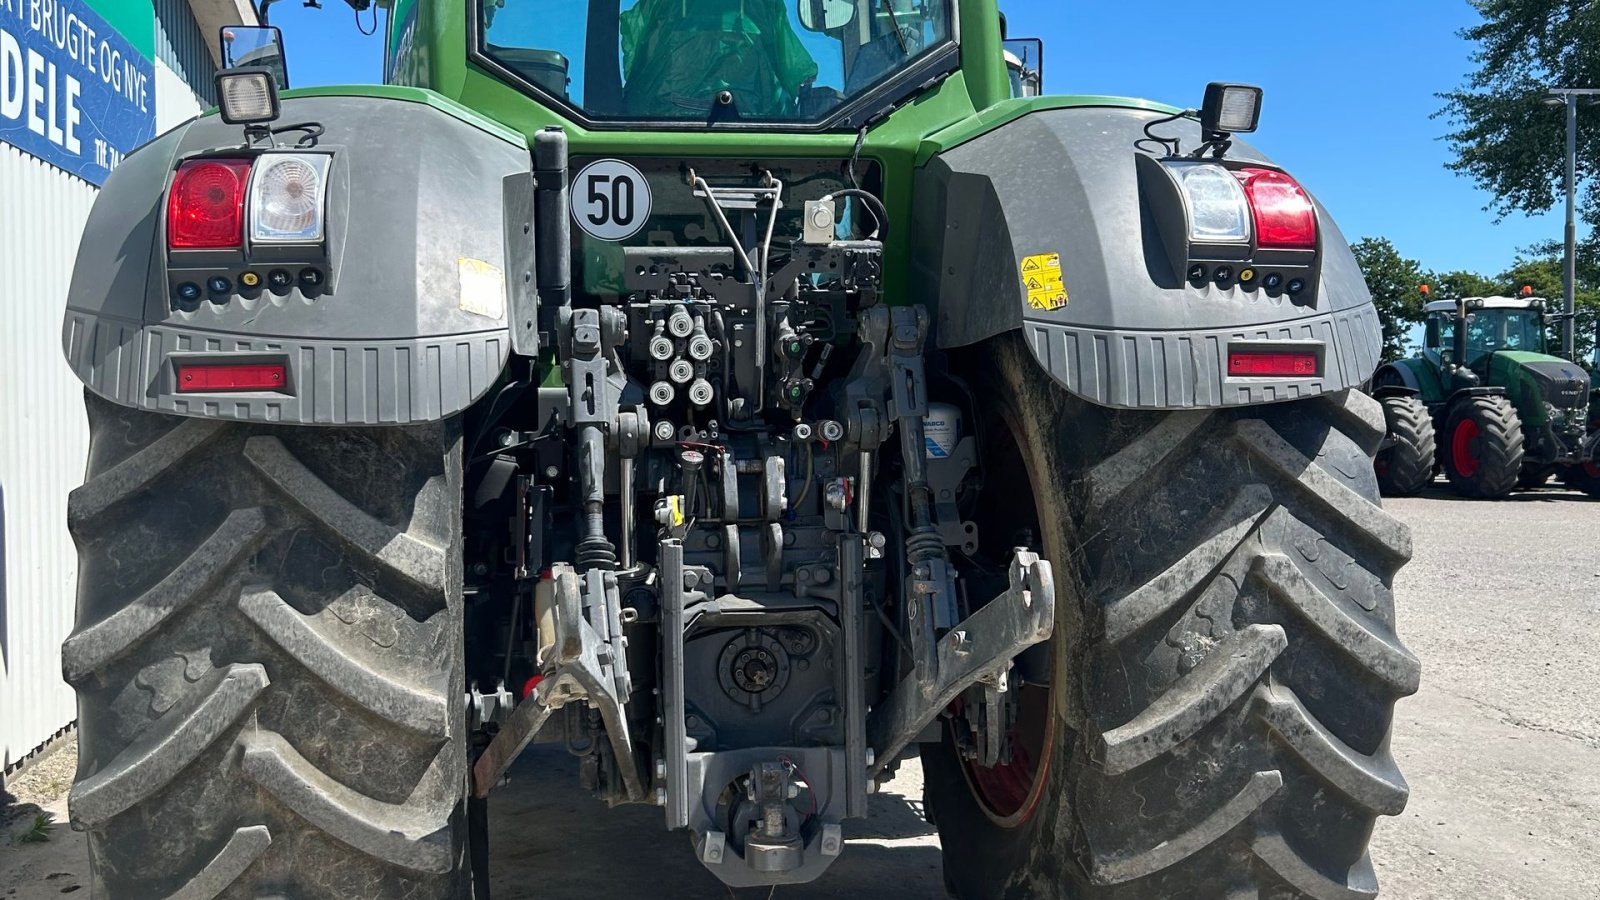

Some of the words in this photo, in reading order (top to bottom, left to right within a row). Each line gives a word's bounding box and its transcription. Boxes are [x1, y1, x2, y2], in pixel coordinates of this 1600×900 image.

[1, 28, 81, 156] DELE
[31, 0, 97, 74] BRUGTE
[100, 40, 121, 93] OG
[124, 59, 148, 114] NYE
[587, 174, 634, 226] 50
